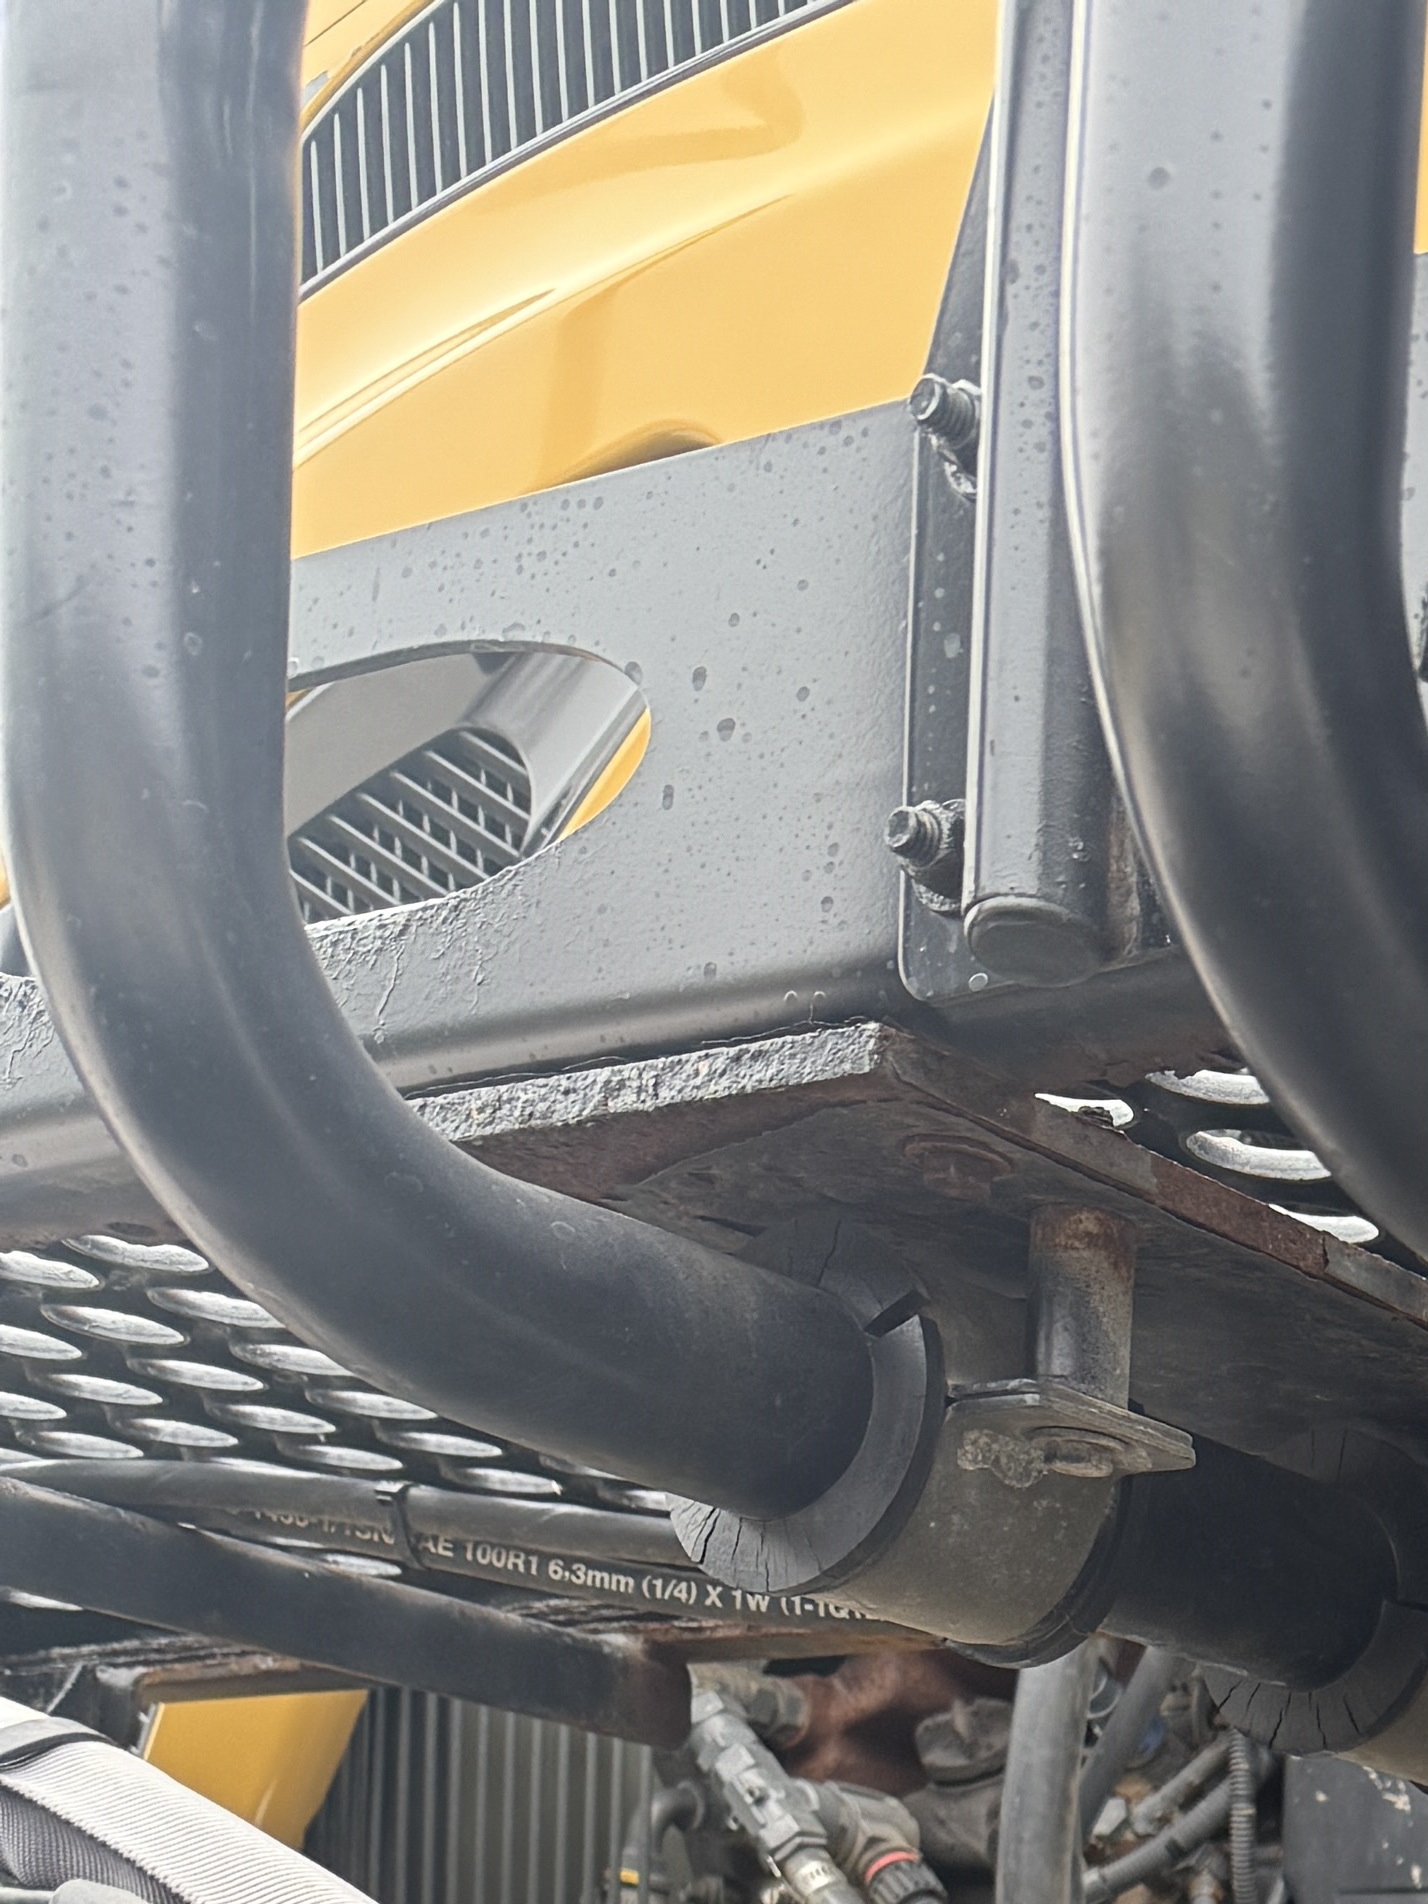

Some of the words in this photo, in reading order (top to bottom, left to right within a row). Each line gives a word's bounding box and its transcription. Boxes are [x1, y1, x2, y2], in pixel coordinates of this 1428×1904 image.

[463, 1537, 540, 1579] 100R1
[547, 1556, 635, 1597] 6,3mm
[642, 1569, 698, 1607] (1/4)
[704, 1585, 725, 1610] X
